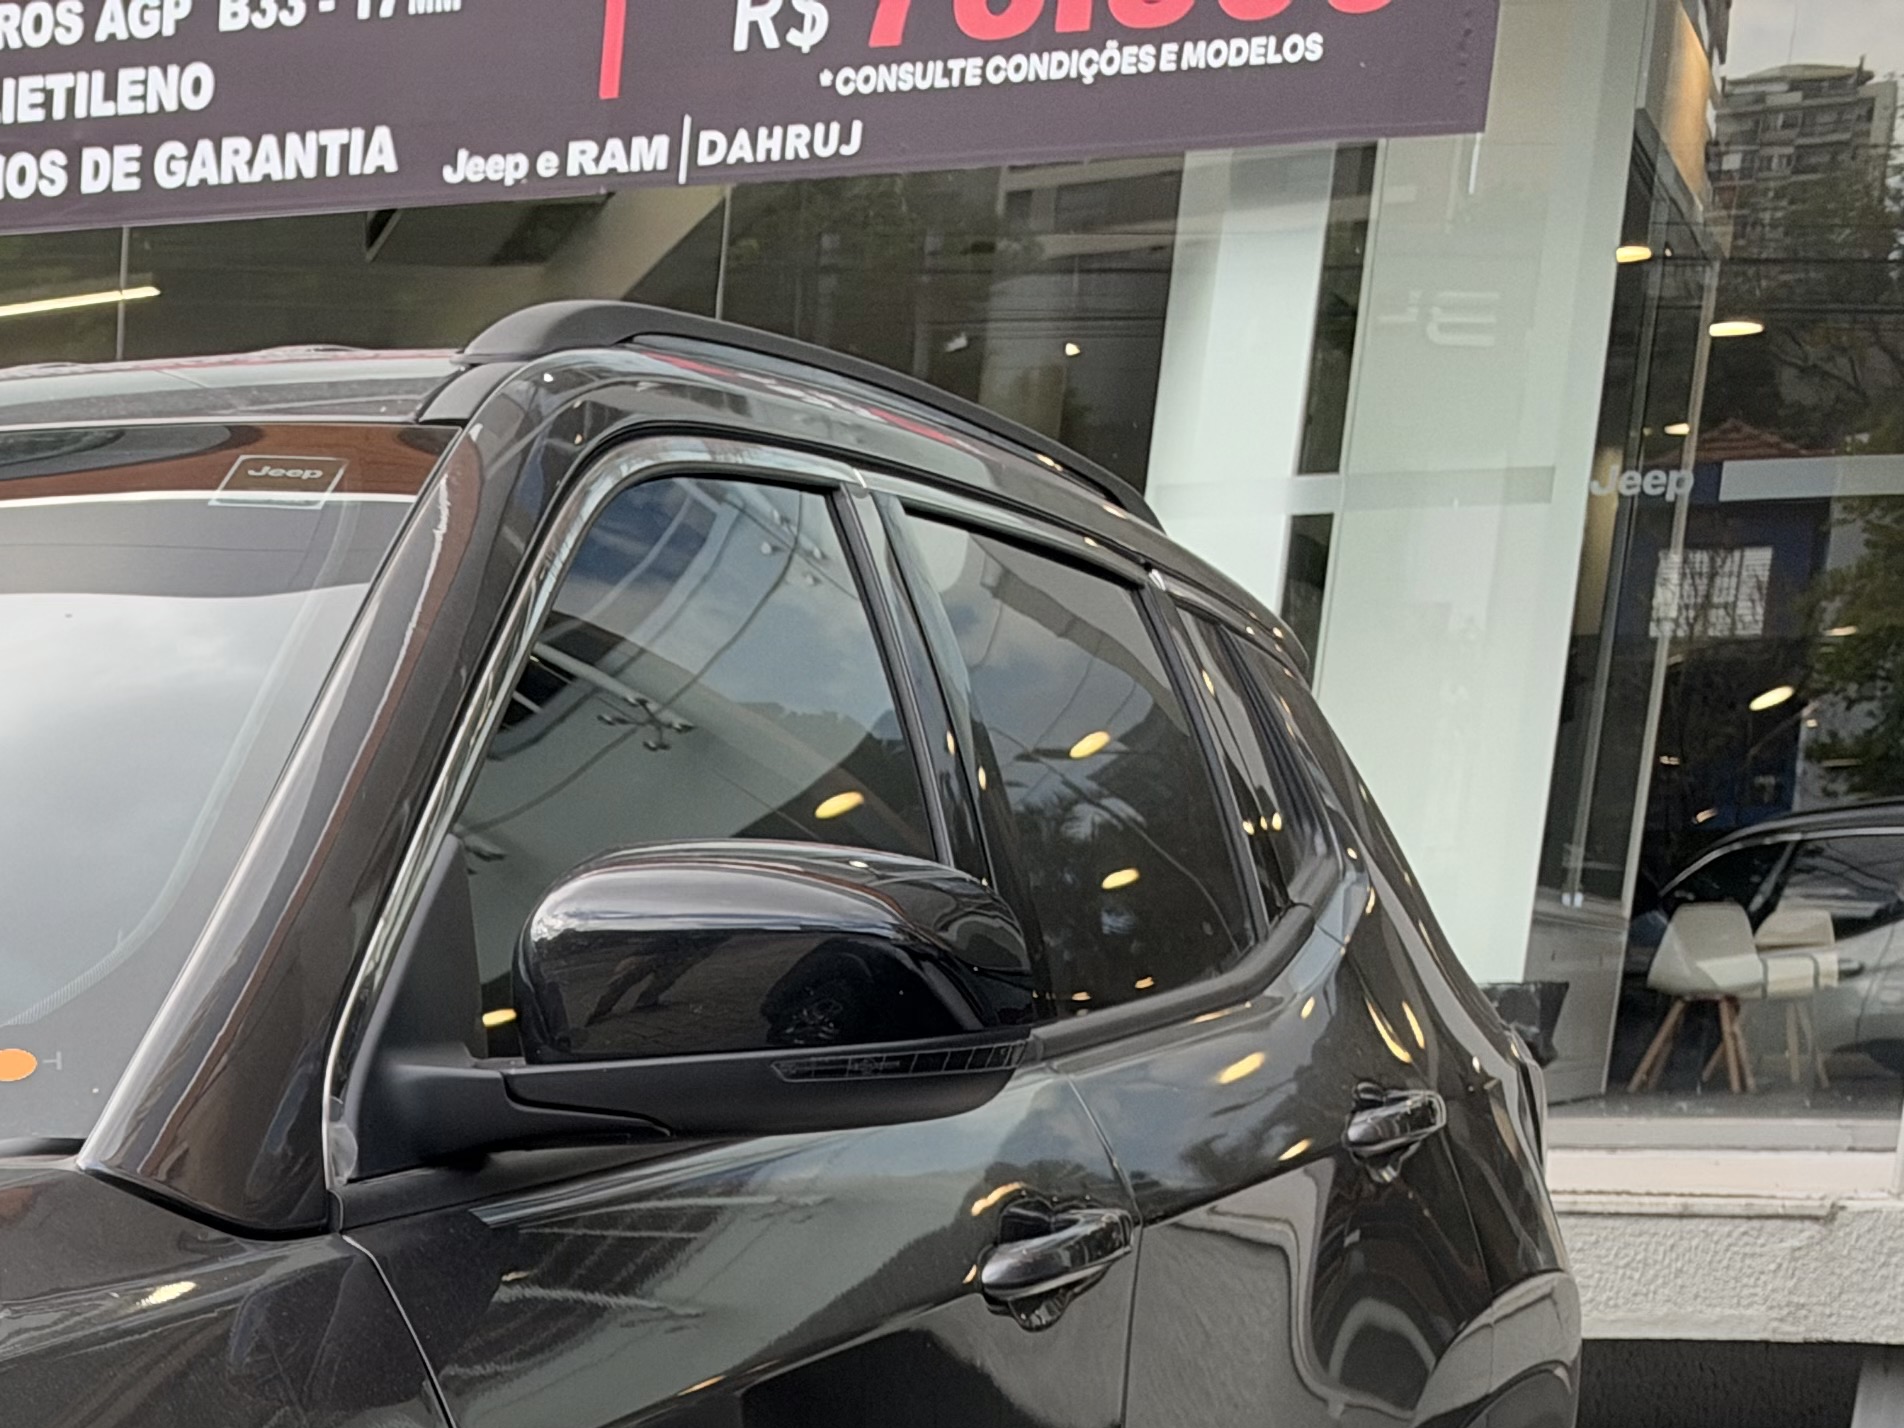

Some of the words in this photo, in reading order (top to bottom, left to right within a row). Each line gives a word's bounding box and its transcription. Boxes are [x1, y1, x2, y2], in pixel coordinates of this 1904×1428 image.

[94, 0, 193, 42] AGP
[985, 39, 1156, 85] CONDIÇÕES
[1159, 42, 1179, 72] E
[1180, 31, 1324, 71] MODELOS
[81, 144, 143, 195] DE
[153, 125, 398, 189] GARANTIA
[443, 147, 529, 187] Jeep
[536, 150, 559, 178] e
[566, 134, 670, 177] RAM
[696, 119, 863, 167] DAHRUJ
[248, 466, 324, 480] Jeep
[1591, 465, 1694, 502] Jeep
